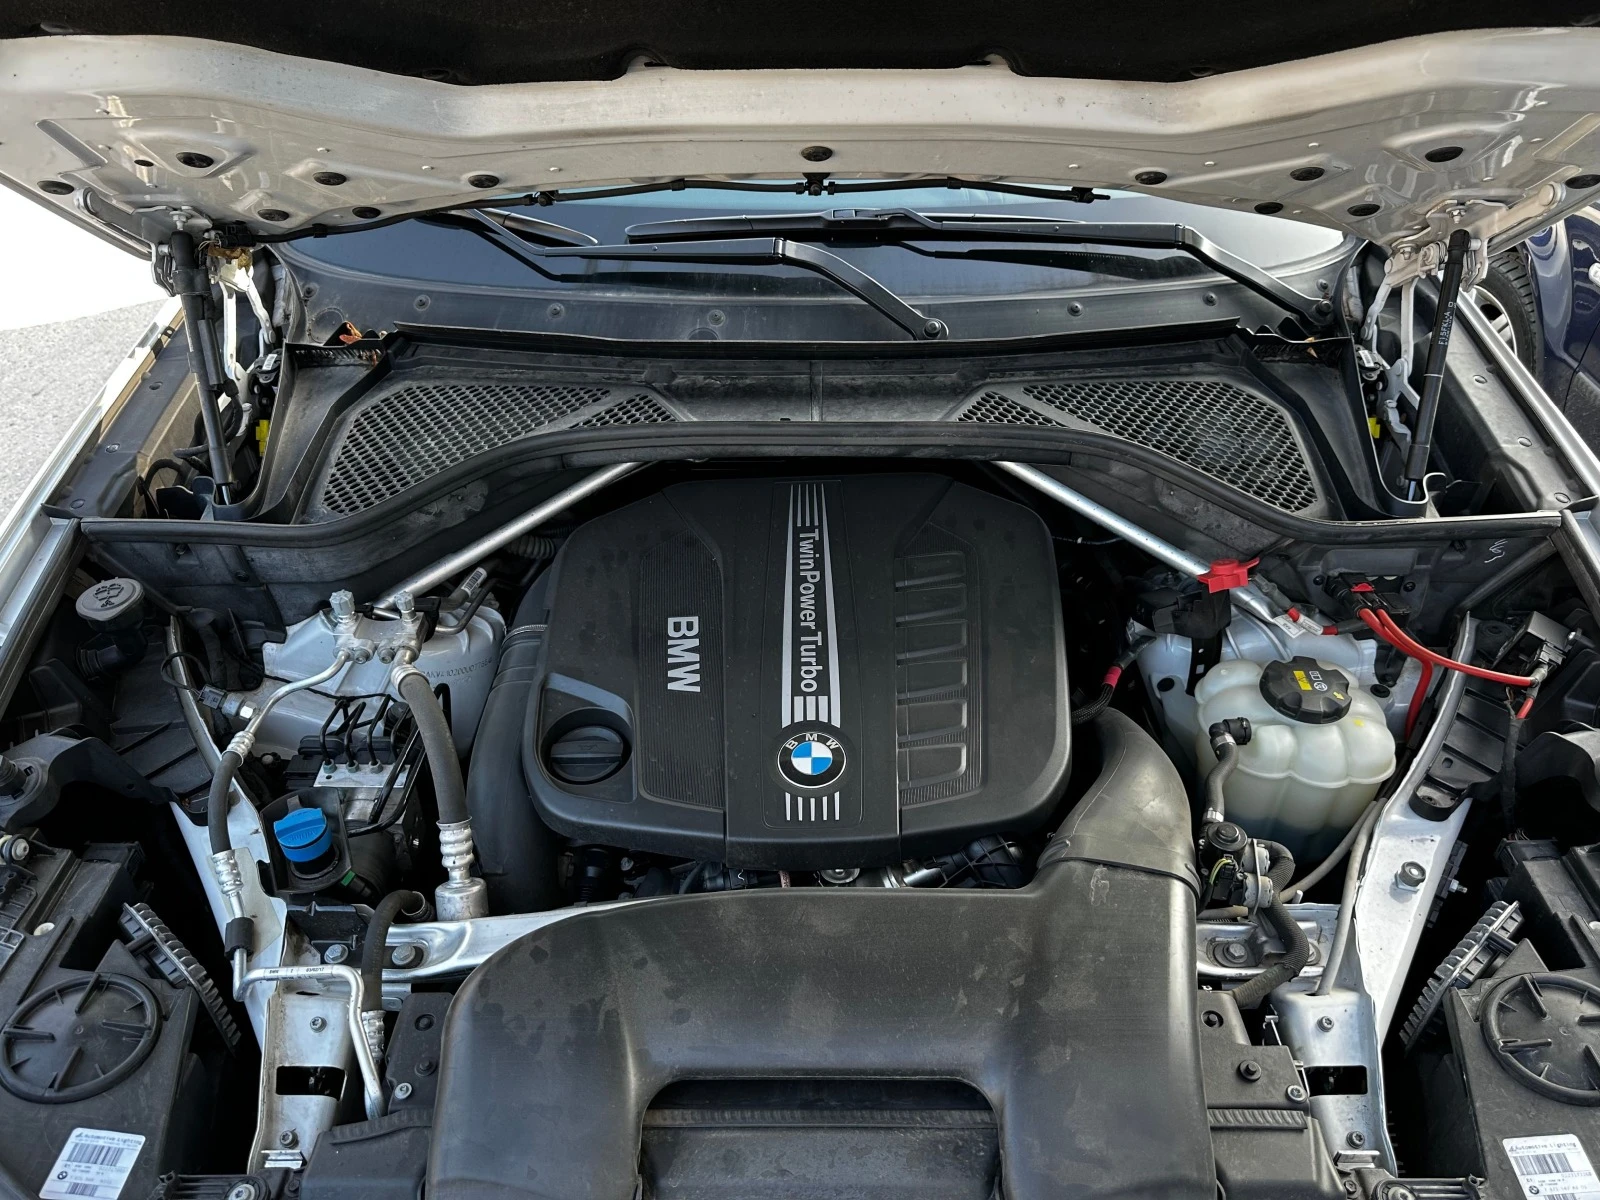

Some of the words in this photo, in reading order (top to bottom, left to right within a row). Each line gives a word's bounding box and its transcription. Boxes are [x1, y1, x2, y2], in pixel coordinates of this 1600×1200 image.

[800, 529, 821, 630] TwinPower
[667, 616, 701, 693] BMW
[800, 631, 823, 693] Turbo
[785, 733, 839, 750] BMW
